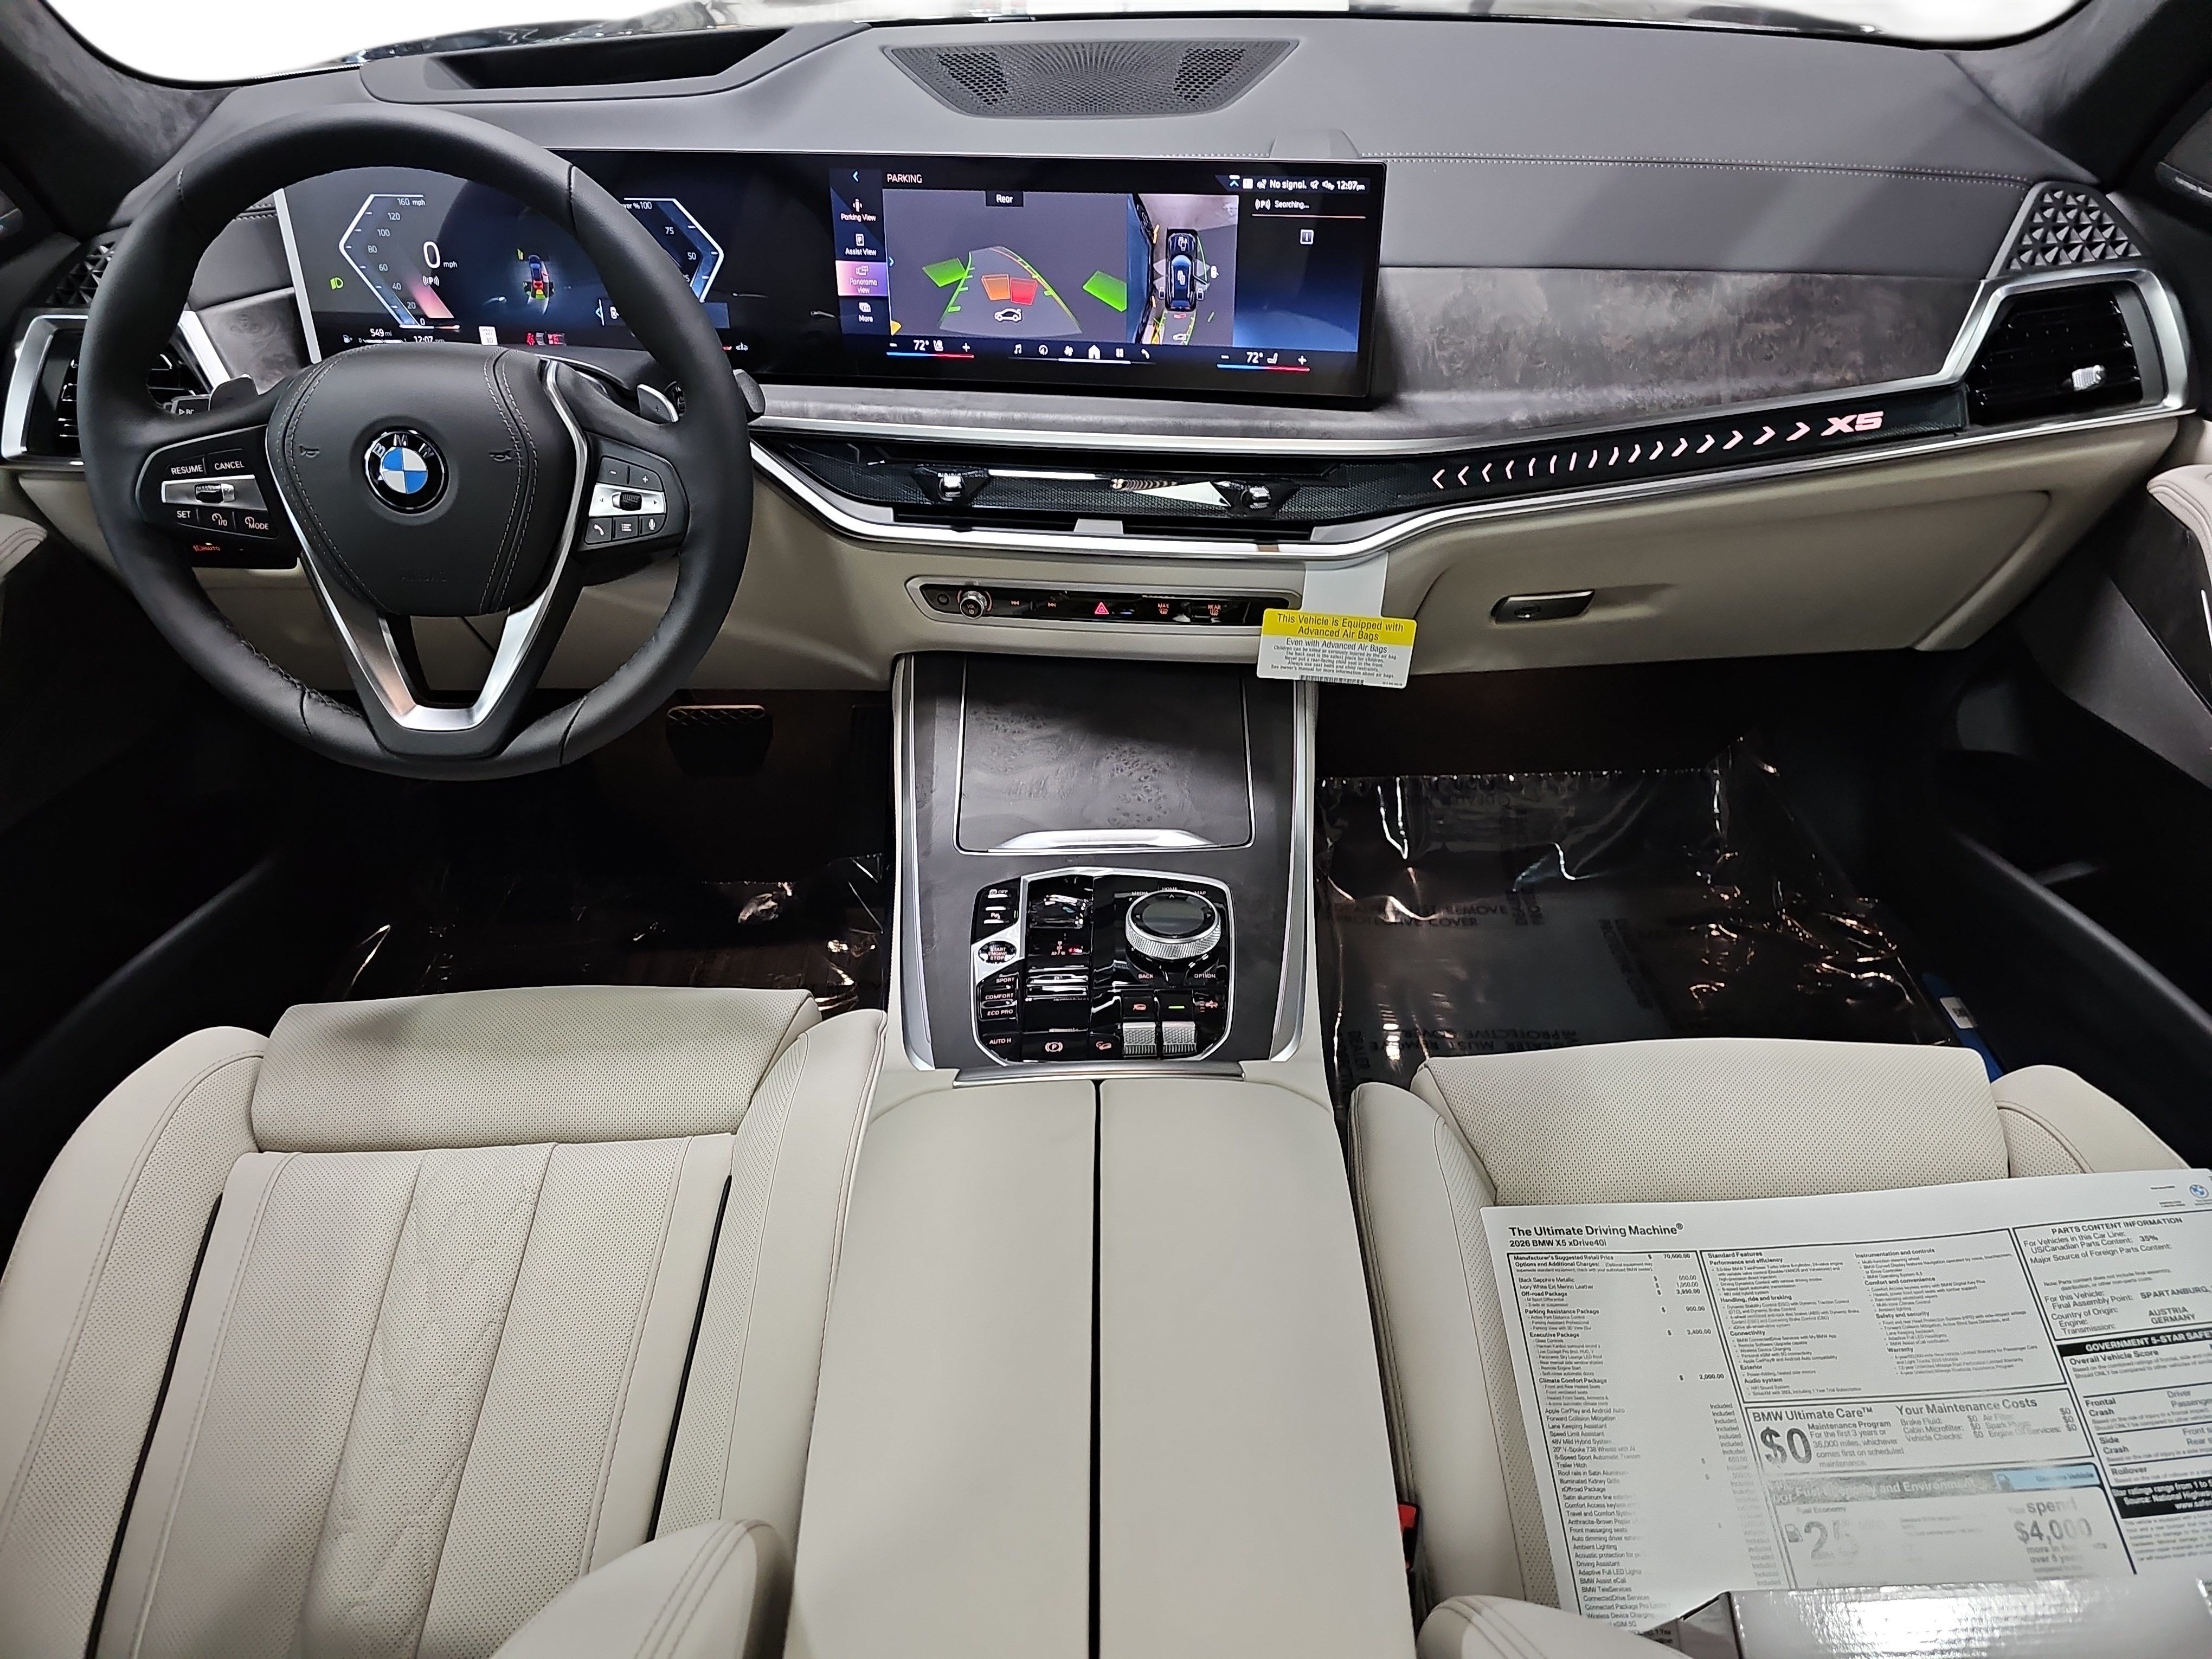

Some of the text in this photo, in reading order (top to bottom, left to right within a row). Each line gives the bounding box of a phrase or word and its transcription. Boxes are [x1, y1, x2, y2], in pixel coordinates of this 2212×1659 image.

[887, 173, 922, 183] PARKING
[1270, 180, 1307, 190] No signal.
[397, 198, 425, 207] 160 mph
[996, 195, 1013, 203] Rear
[388, 213, 401, 221] 120
[841, 213, 876, 222] Parking View
[377, 229, 390, 237] 100
[368, 245, 377, 254] 80
[863, 248, 877, 256] View
[423, 241, 440, 269] 0
[379, 263, 388, 272] 60
[443, 261, 458, 269] mph
[392, 282, 401, 291] 40
[407, 301, 416, 310] 20
[858, 314, 873, 323] More
[370, 329, 384, 337] 549
[914, 339, 929, 351] 72°
[1246, 352, 1263, 364] 72°
[1821, 411, 1884, 436] X5
[372, 434, 434, 458] BMW
[171, 465, 203, 475] RESUME
[215, 461, 245, 470] CANCEL
[248, 522, 269, 530] MODE
[1277, 613, 1404, 632] This Vehicle is Equipped with
[1297, 626, 1379, 641] Advanced Air Bags
[1287, 638, 1303, 646] Even
[1322, 640, 1356, 650] Advanced
[1370, 644, 1387, 653] Bags
[2051, 1217, 2183, 1234] PARTS CONTENT INFORMATION
[1509, 1227, 1532, 1236] The
[1533, 1226, 1583, 1236] Ultimate
[1585, 1226, 1626, 1237] Driving
[2030, 1243, 2079, 1253] US/Canadian
[2101, 1235, 2132, 1245] Content:
[2037, 1237, 2069, 1245] Vehicles
[1855, 1250, 1900, 1258] Instrumentation
[2053, 1253, 2080, 1261] Source
[2089, 1247, 2117, 1257] Foreign
[2118, 1244, 2139, 1253] Parts
[2051, 1311, 2081, 1320] Country
[2092, 1307, 2118, 1315] Origin:
[2149, 1307, 2189, 1316] AUSTRIA
[2059, 1319, 2088, 1328] Engine:
[2151, 1313, 2195, 1324] GERMANY
[2061, 1323, 2115, 1335] Transmission:
[2085, 1333, 2185, 1352] GOVERNMENT 5-STAR
[2069, 1349, 2158, 1365] Overall Vehicle Score
[1895, 1398, 2037, 1416] Your Maintenance Costs
[1752, 1411, 1783, 1422] BMW
[1785, 1409, 1835, 1420] Ultimate
[1808, 1422, 1857, 1430] Maintenance
[1760, 1426, 1812, 1468] $0
